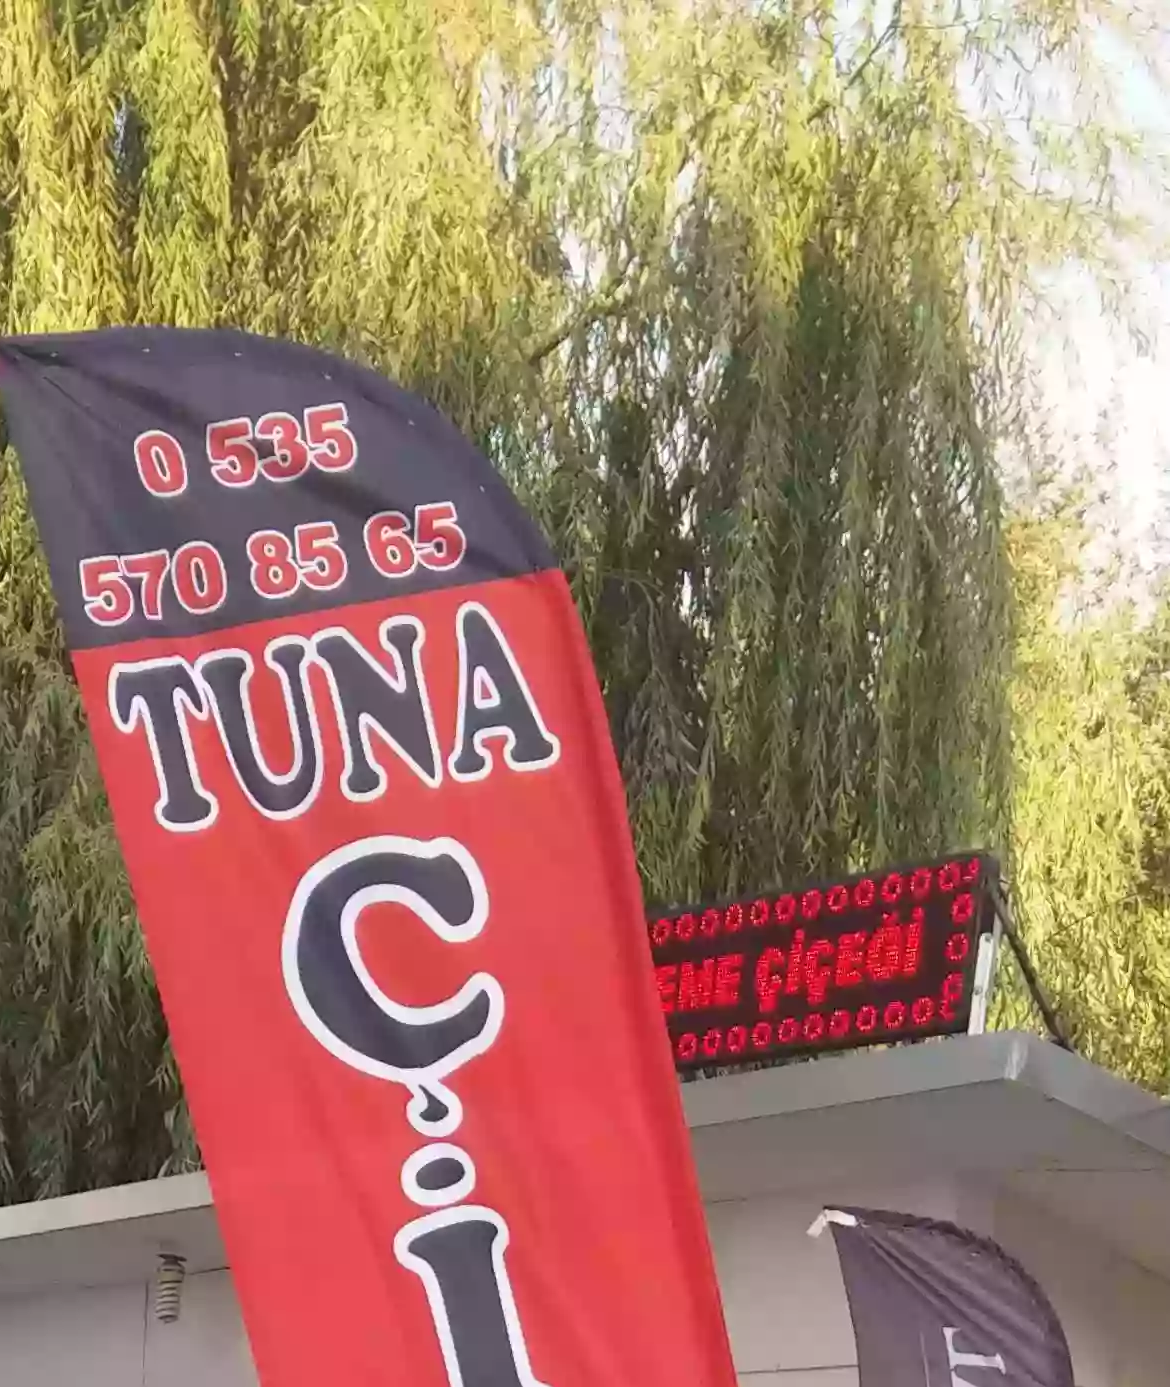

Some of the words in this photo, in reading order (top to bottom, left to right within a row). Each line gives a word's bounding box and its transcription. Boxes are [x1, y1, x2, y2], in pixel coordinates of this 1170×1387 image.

[134, 430, 187, 498] 0
[206, 402, 356, 488] 535
[79, 540, 228, 627] 570
[245, 521, 348, 599] 85
[365, 501, 467, 578] 65
[108, 600, 561, 832] TUNA
[754, 905, 926, 1013] ÇİÇEĞİ
